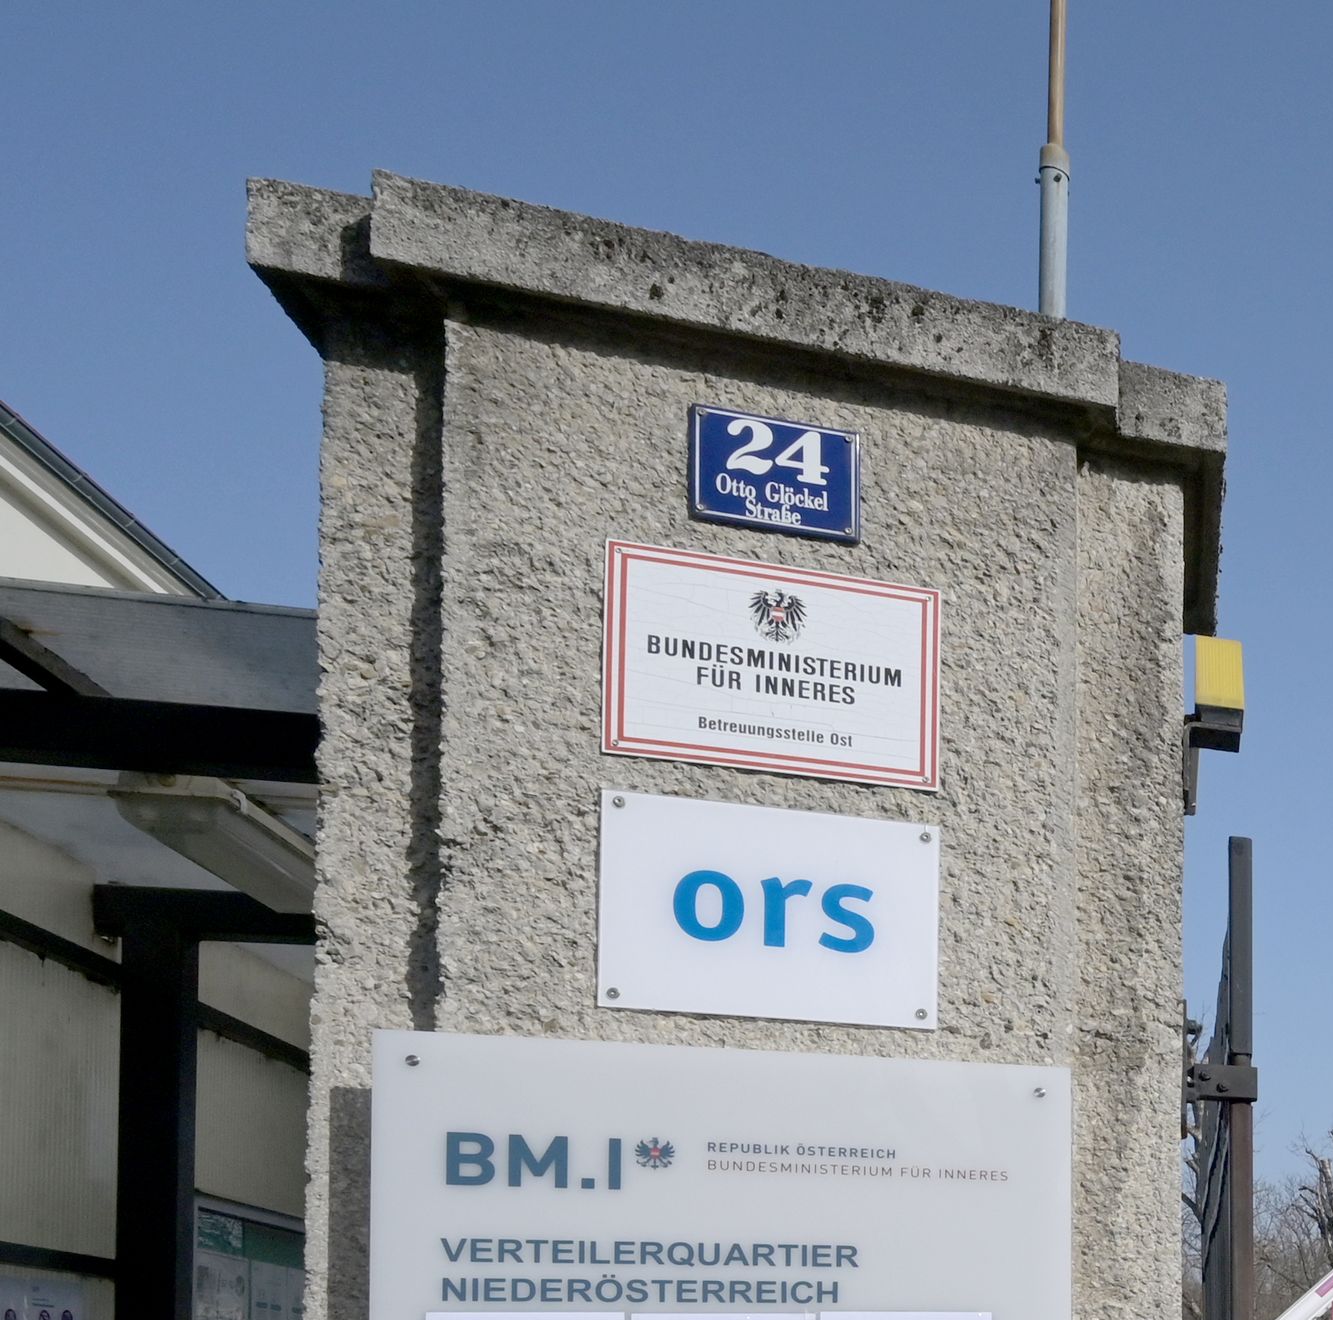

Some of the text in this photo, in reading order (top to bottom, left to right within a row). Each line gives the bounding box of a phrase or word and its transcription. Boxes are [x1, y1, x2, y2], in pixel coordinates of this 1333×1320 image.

[725, 418, 831, 486] 24
[715, 472, 829, 512] Otto Glöckel
[743, 497, 802, 526] Straße
[646, 634, 903, 688] BUNDESMINISTERIUM
[696, 665, 856, 705] FÜR INNERES
[697, 716, 853, 748] Betreuungsstelle Ost
[672, 869, 875, 954] ors
[445, 1131, 622, 1191] BM.I
[707, 1141, 897, 1159] REPUBLIK ÖSTERREICH
[707, 1159, 1009, 1182] BUNDESMINISTERIUM FÜR INNERES
[440, 1237, 860, 1268] VERTEILERQUARTIER
[440, 1274, 840, 1304] NIEDERÖSTERREICH
